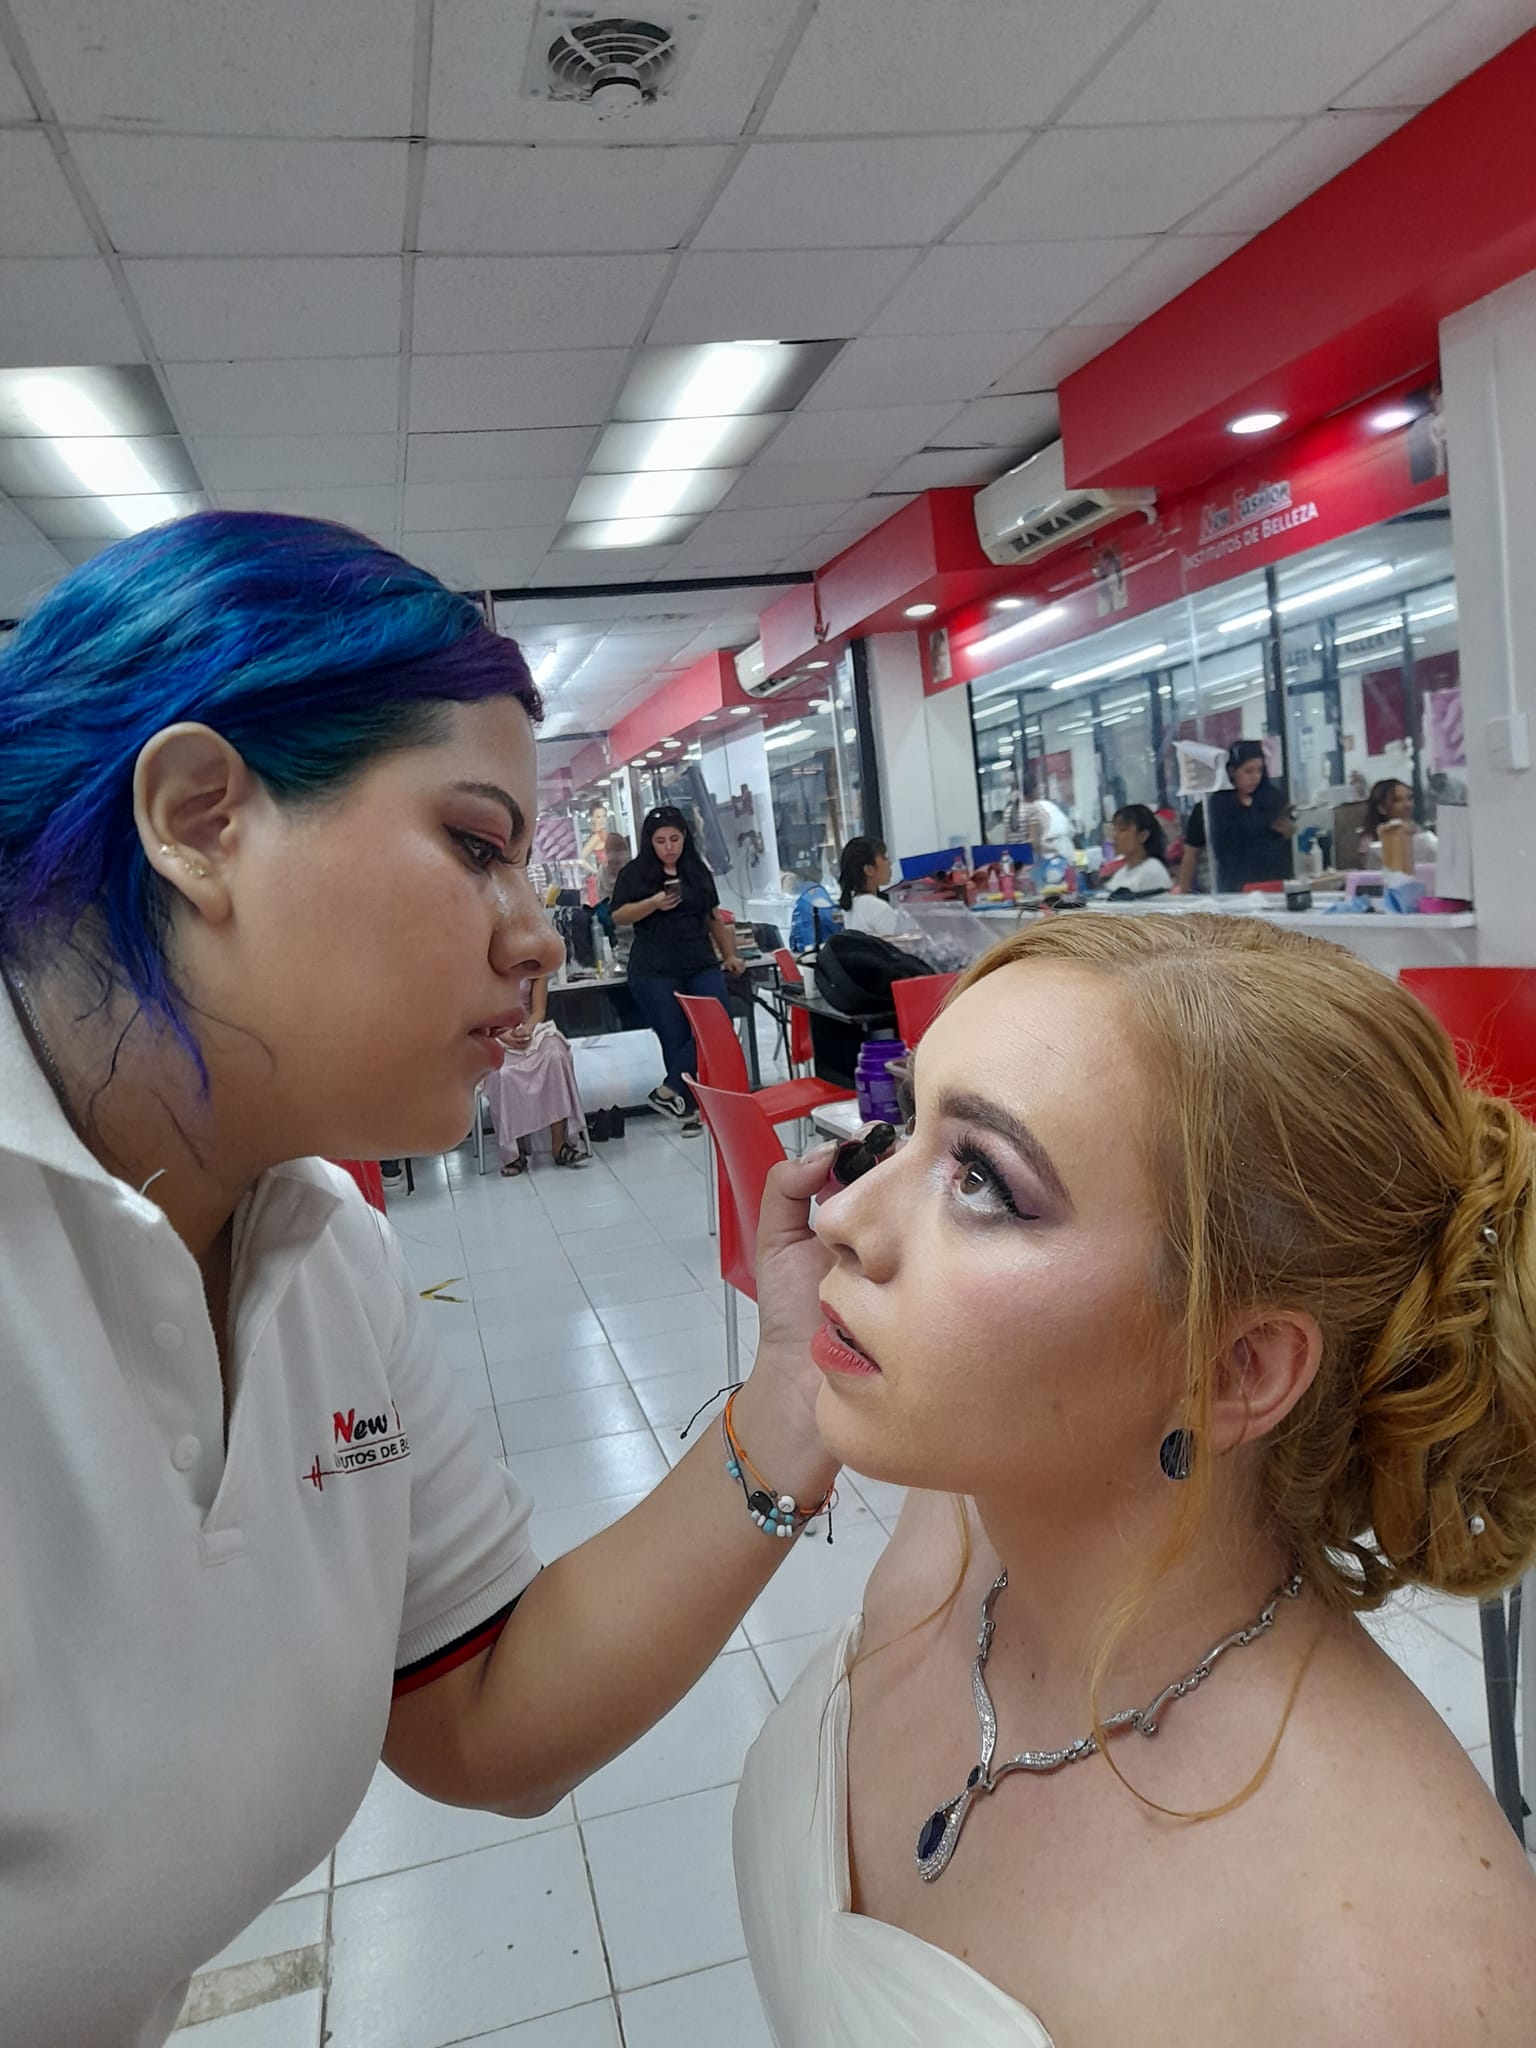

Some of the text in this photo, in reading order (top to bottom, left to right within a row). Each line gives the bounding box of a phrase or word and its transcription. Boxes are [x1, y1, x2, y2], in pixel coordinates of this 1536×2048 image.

[1243, 526, 1259, 546] DE
[1262, 502, 1318, 537] BELLEZA
[333, 1408, 387, 1445] New
[380, 1444, 398, 1458] DE
